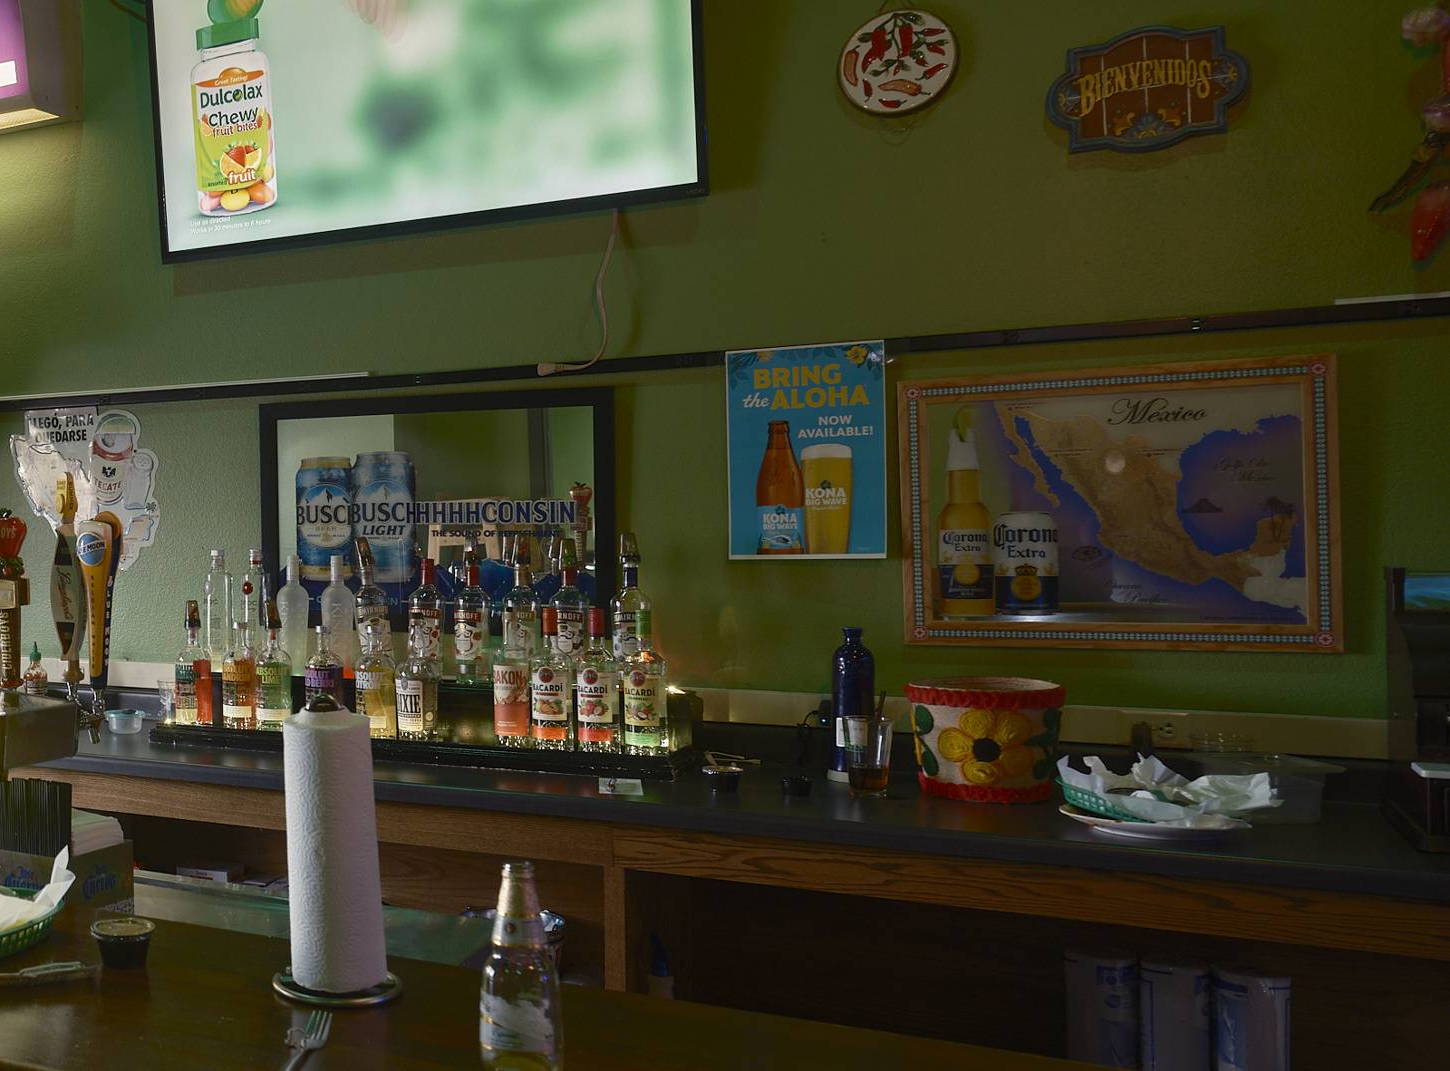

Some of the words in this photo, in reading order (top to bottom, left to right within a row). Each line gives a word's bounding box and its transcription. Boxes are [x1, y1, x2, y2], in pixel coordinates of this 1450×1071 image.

[1075, 58, 1212, 118] BIENVENIDOS
[200, 84, 263, 109] Dulcolax
[213, 126, 233, 137] fruit
[237, 121, 258, 132] bites
[228, 168, 256, 185] fruit
[753, 364, 842, 389] BRING
[742, 392, 771, 408] the
[770, 384, 870, 410] ALOHA
[65, 414, 94, 428] PARA
[818, 415, 853, 426] NOW
[798, 425, 874, 439] AVAILABLE!
[94, 478, 121, 491] TECATE
[805, 487, 847, 498] KONA
[805, 498, 821, 506] BIG
[822, 497, 848, 505] WAVE
[762, 512, 798, 523] KONA
[362, 524, 407, 537] LIGHT
[431, 530, 448, 538] THE
[449, 530, 481, 538] SOUND
[483, 530, 496, 538] OF
[86, 541, 106, 552] MOON
[955, 543, 981, 552] Extra
[1007, 544, 1046, 558] Extra
[557, 611, 582, 622] RNOFF
[613, 613, 635, 622] SMIRN
[1, 611, 13, 670] CIDERBOYS
[261, 675, 280, 685] LIME
[533, 684, 563, 692] BACARDÍ
